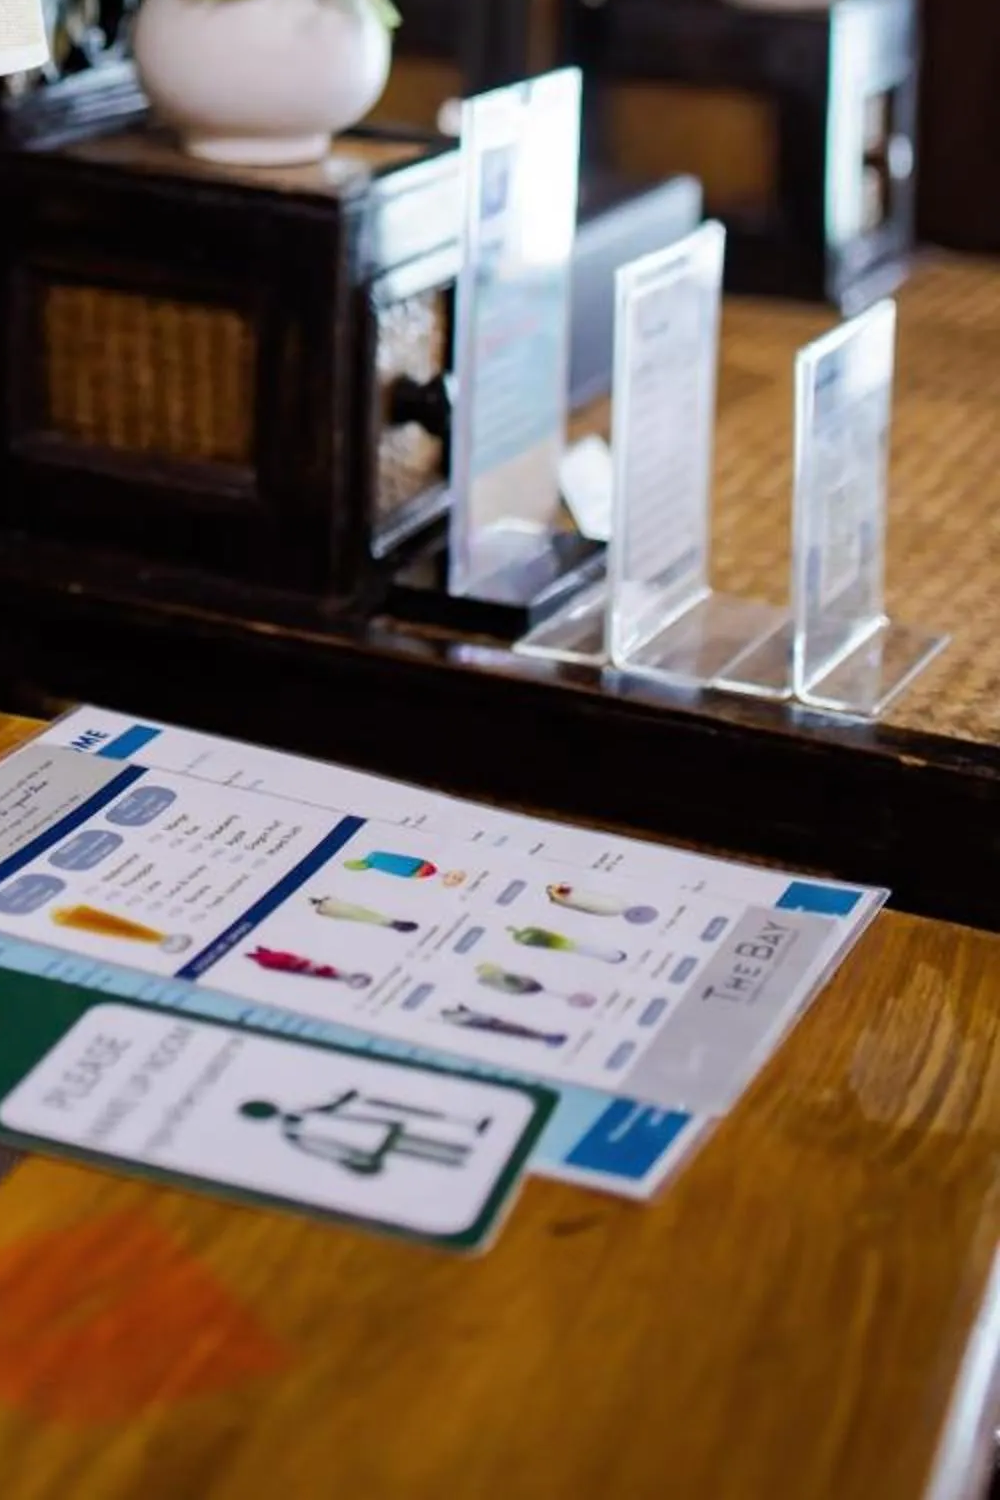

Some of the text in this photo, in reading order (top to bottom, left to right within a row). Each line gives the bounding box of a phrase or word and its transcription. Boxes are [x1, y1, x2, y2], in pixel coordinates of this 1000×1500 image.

[72, 729, 109, 753] ME
[701, 963, 761, 1001] THE
[734, 920, 790, 960] BAY
[42, 1033, 133, 1111] PLEASE
